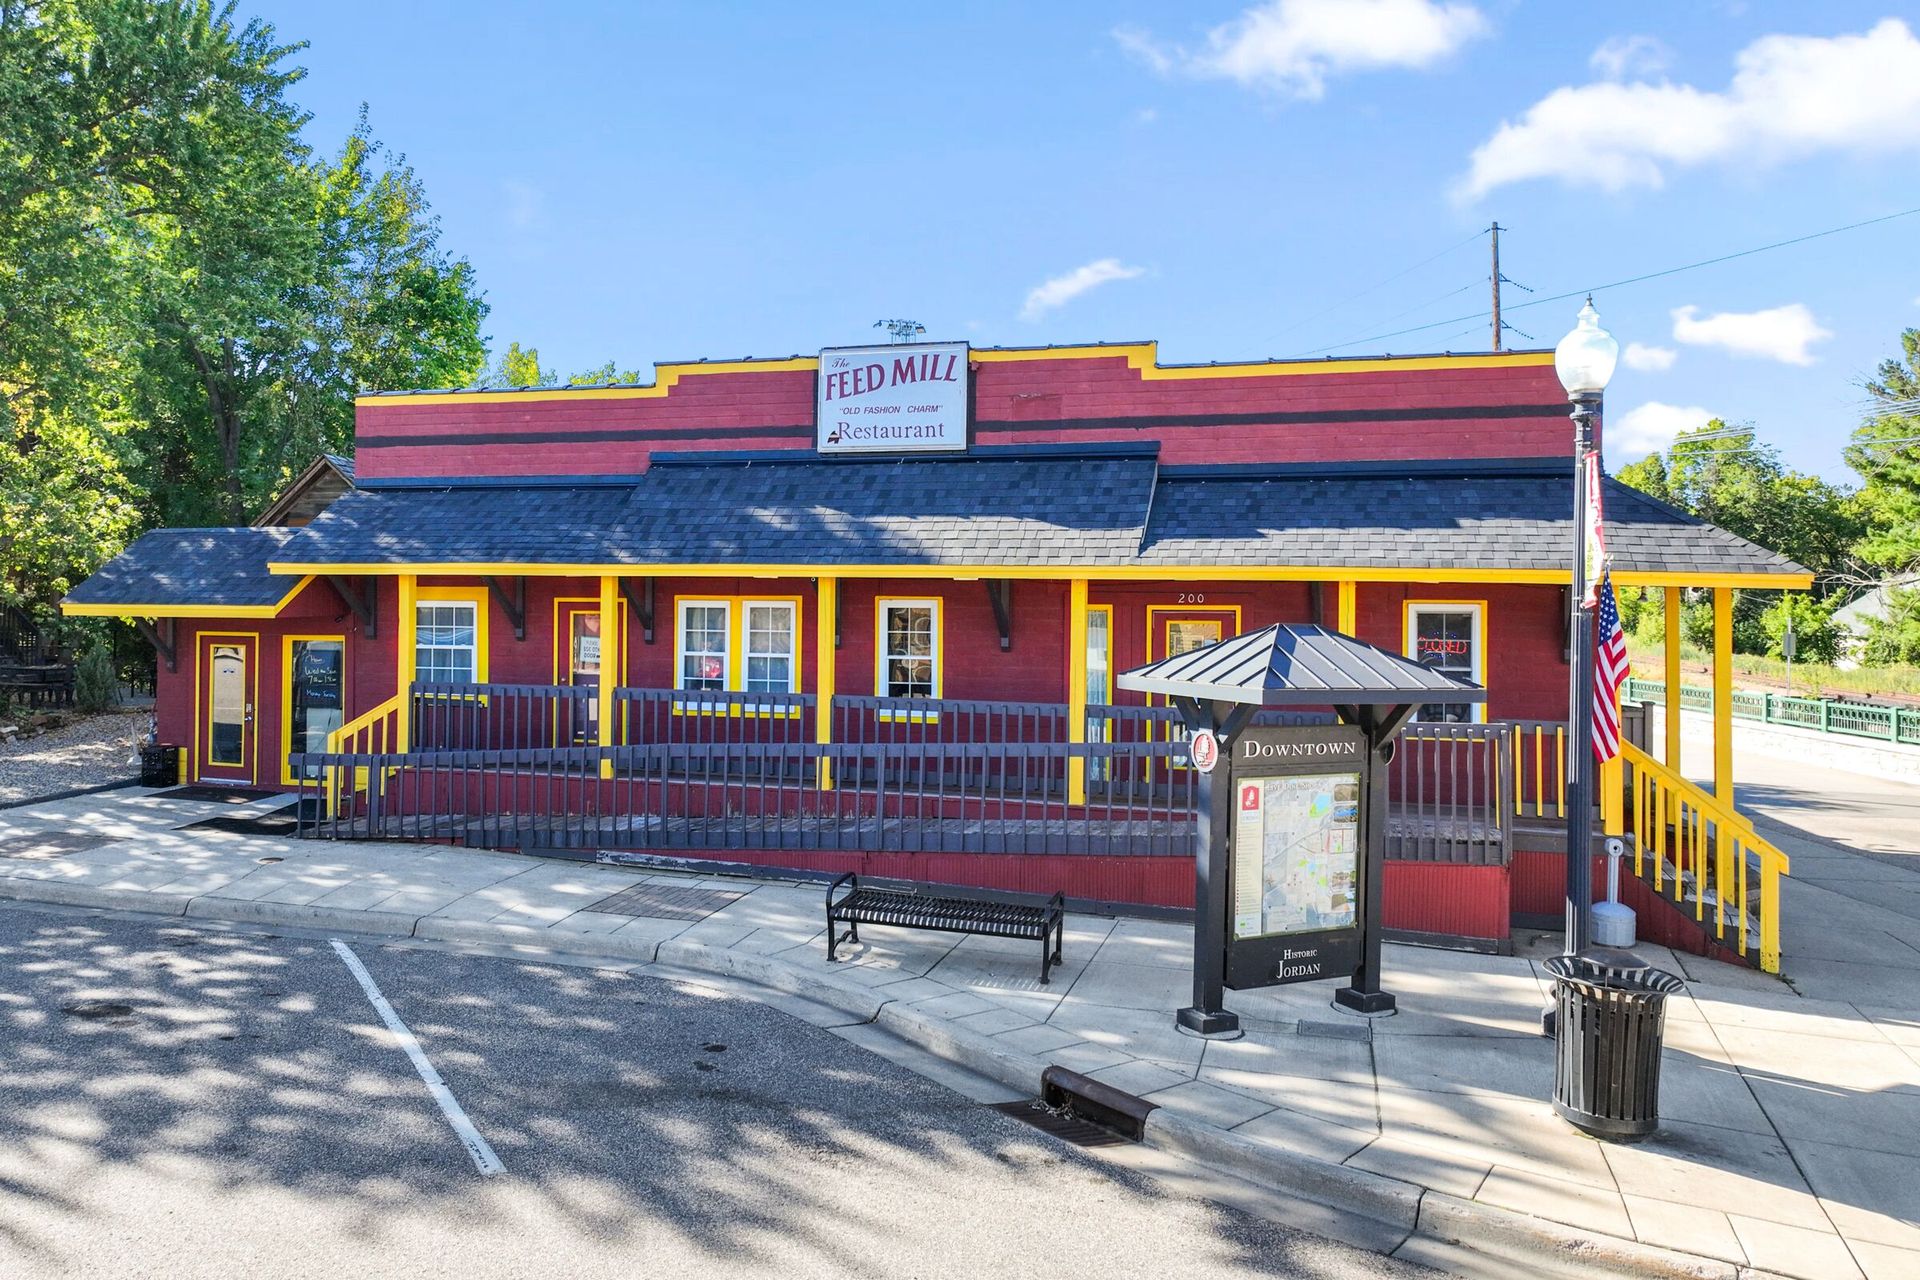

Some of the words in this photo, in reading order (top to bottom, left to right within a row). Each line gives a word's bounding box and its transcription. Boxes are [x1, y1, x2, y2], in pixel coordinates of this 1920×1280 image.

[831, 357, 850, 369] The
[825, 363, 886, 401] FEED
[891, 354, 958, 387] MILL
[863, 406, 901, 414] FASHION
[837, 421, 945, 440] Restaurant
[1178, 593, 1205, 604] 200
[1243, 740, 1356, 759] DOWNTOWN
[1276, 960, 1321, 979] JORDAN
